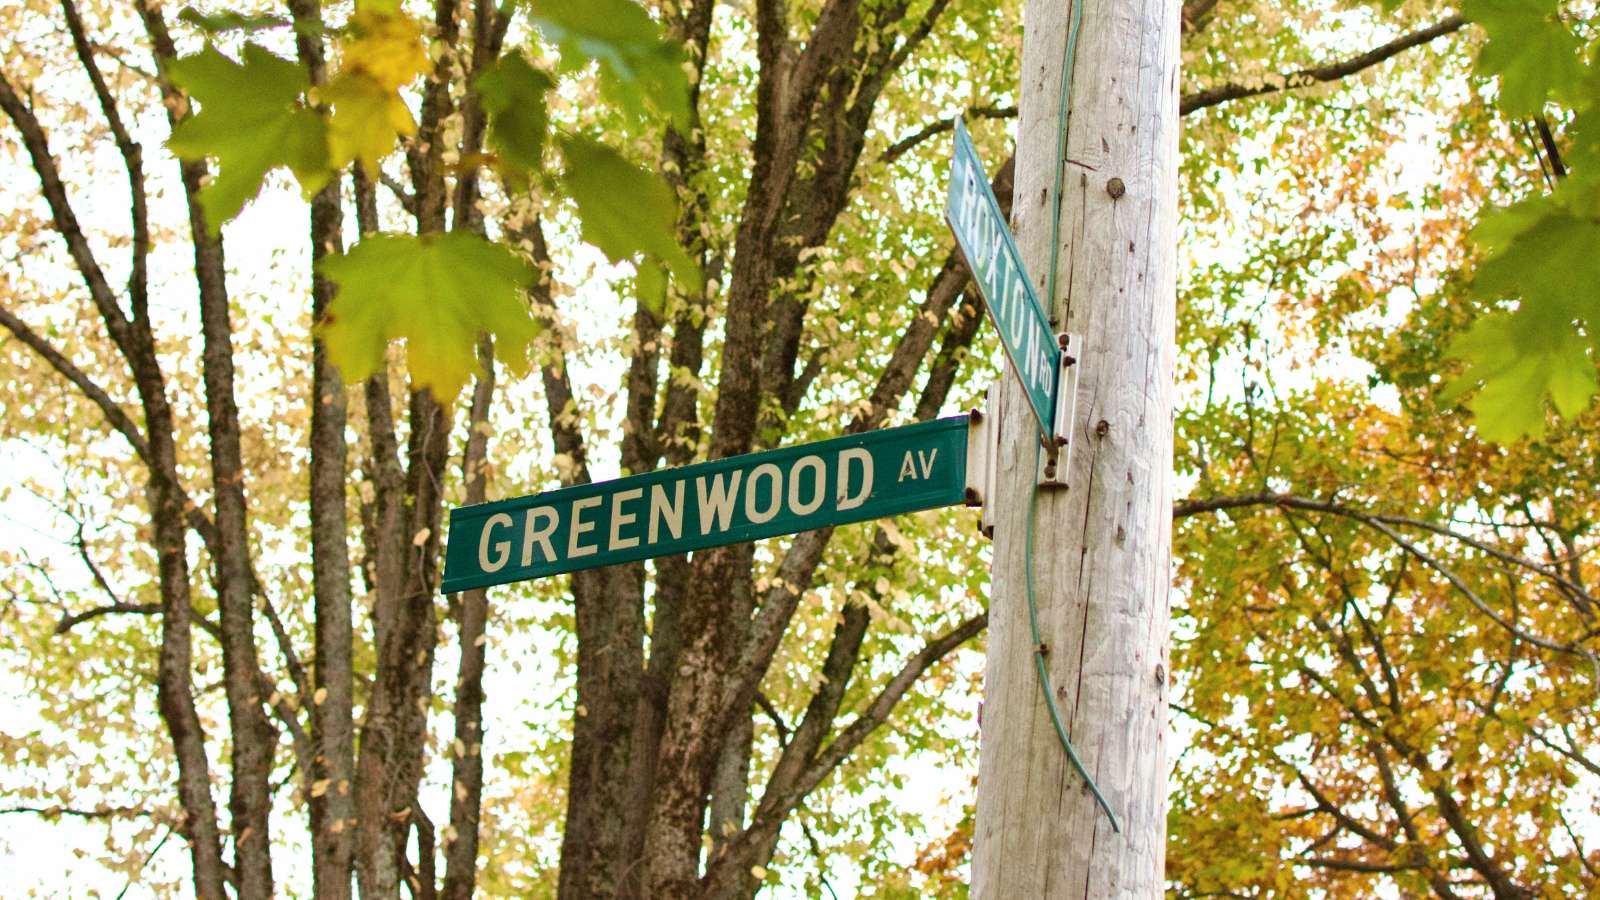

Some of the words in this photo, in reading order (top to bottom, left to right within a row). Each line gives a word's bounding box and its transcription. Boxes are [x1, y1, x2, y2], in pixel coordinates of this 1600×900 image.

[959, 156, 1040, 391] ROXTON
[1039, 350, 1053, 399] RD
[477, 447, 874, 573] GREENWOOD
[897, 447, 938, 482] AV
